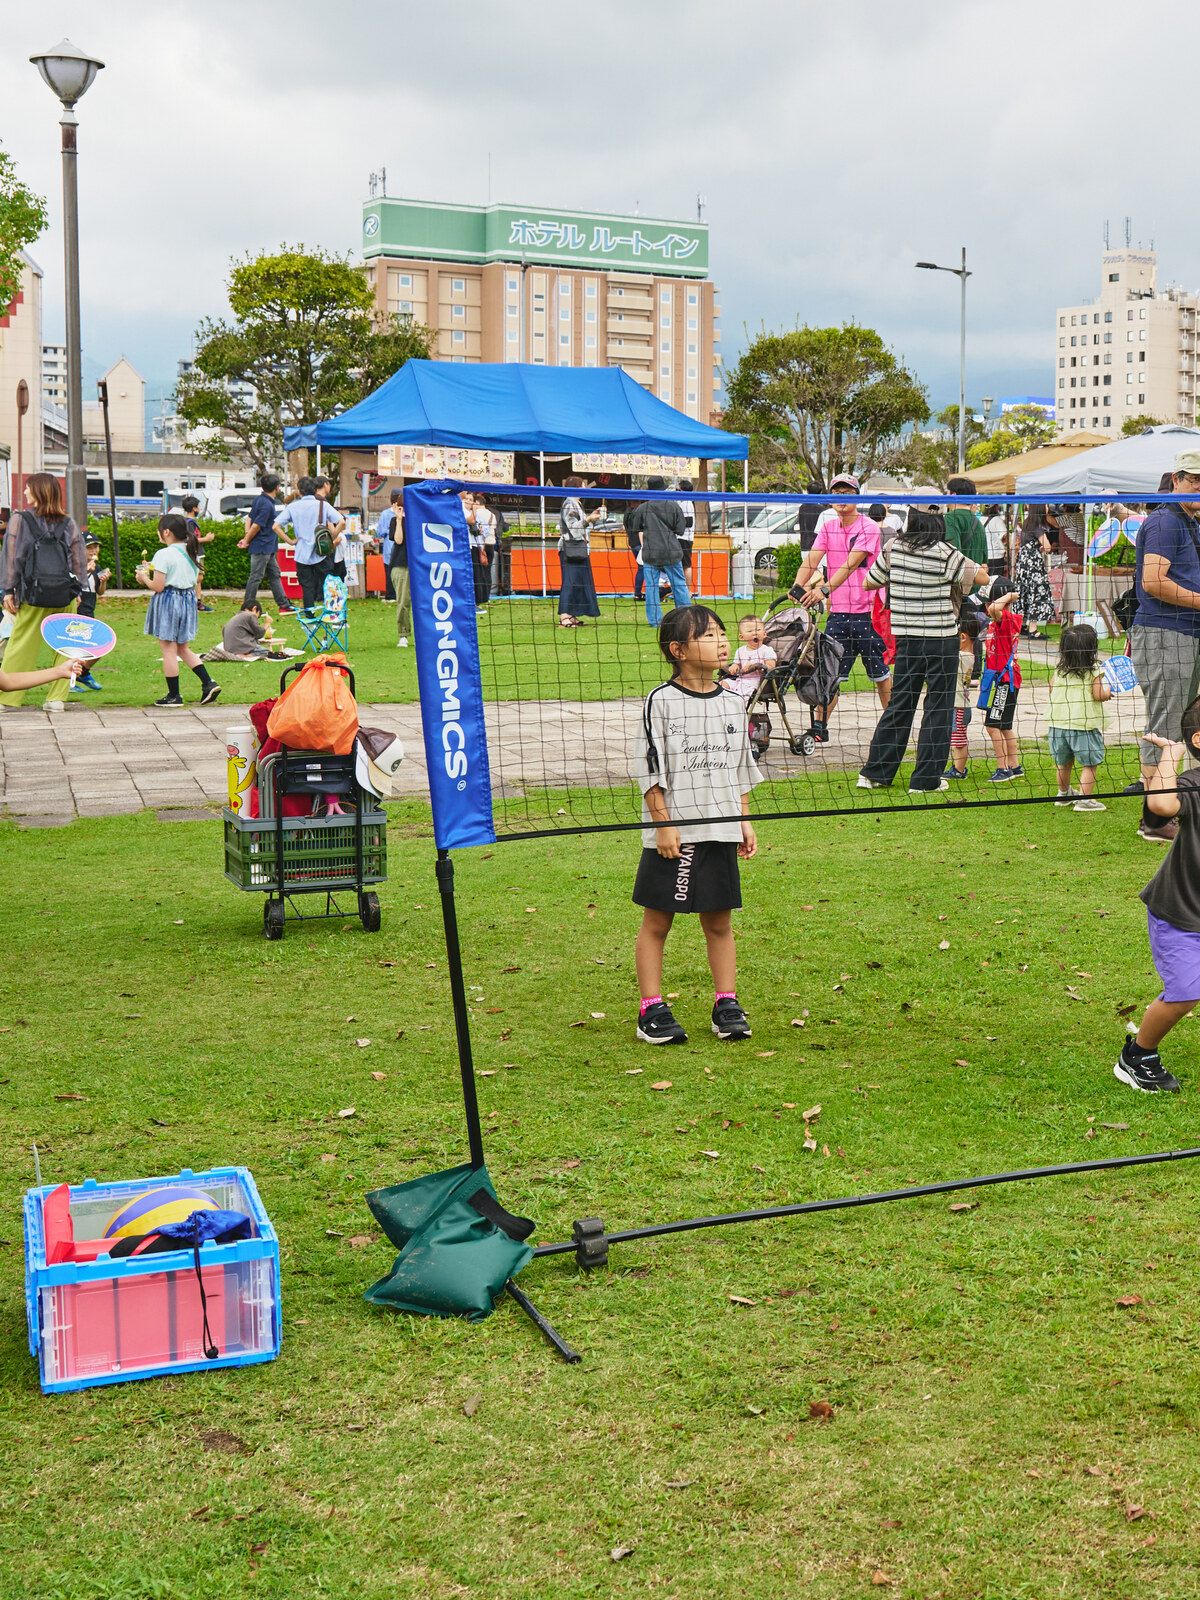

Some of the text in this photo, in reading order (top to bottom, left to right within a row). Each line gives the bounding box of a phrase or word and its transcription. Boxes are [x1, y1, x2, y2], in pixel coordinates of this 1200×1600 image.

[509, 219, 699, 258] ホテル ルートイン
[430, 562, 468, 780] SONGMICS
[674, 844, 695, 901] NYANSPO
